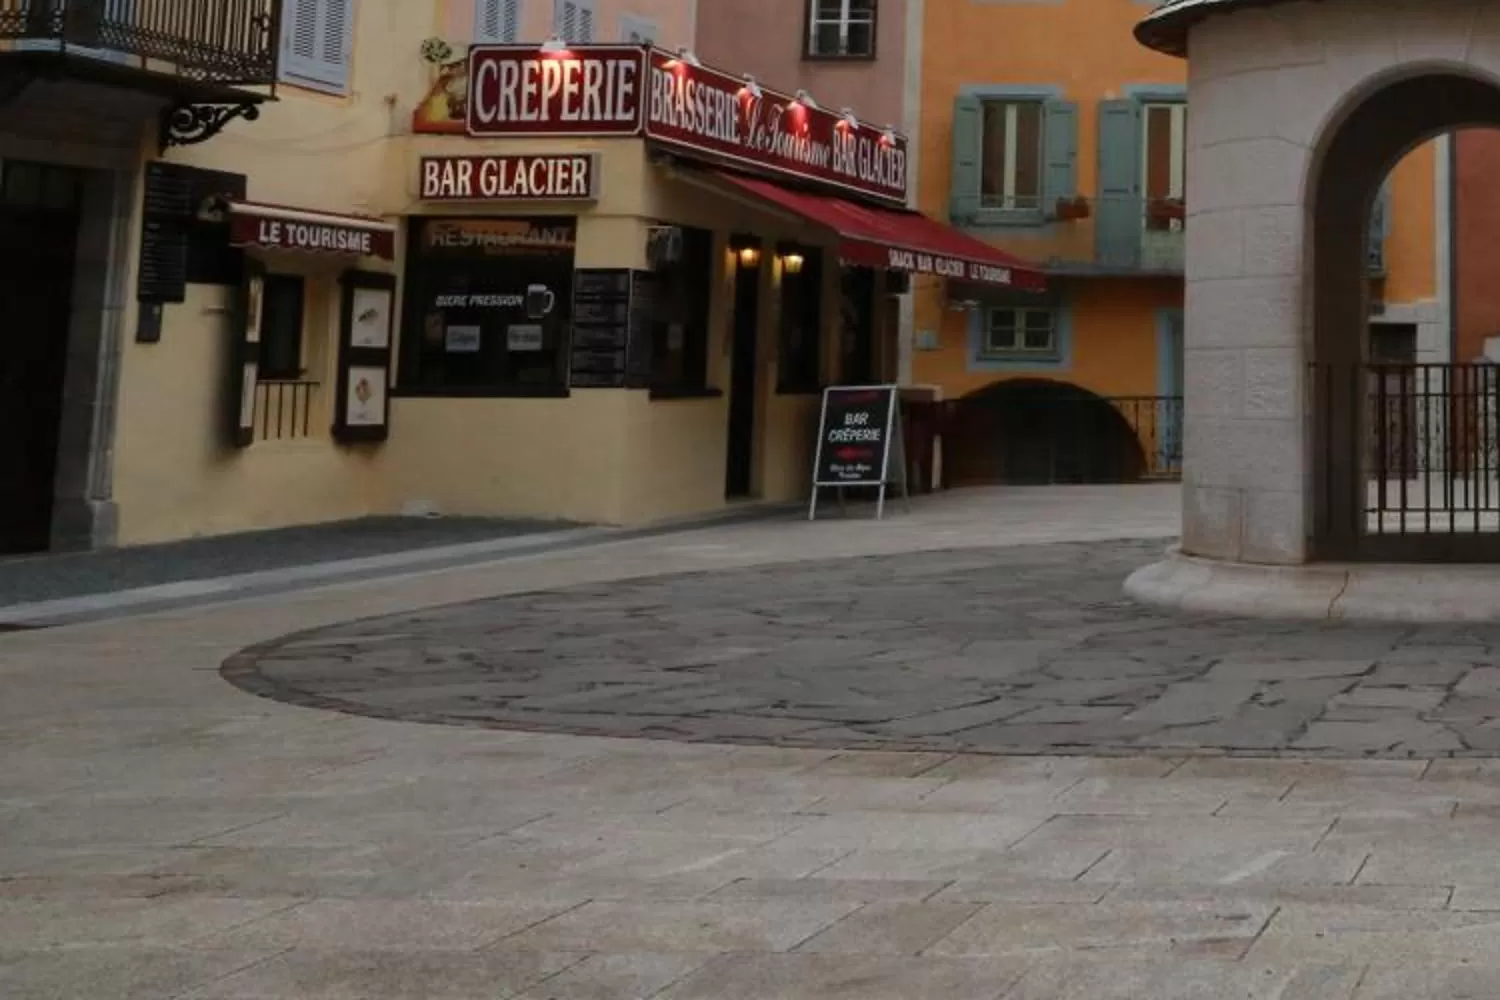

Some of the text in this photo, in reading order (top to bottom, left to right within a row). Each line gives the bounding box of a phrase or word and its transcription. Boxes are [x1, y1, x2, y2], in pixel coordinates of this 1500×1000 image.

[475, 59, 636, 123] CREPERIE
[650, 67, 906, 191] BRASSERIE Le Tourisme BAR GLACIER
[424, 158, 587, 197] BAR GLACIER
[259, 221, 371, 253] LE TOURISME
[888, 248, 915, 269] SNACK
[917, 255, 933, 271] BAR
[935, 258, 965, 277] GLACIER
[969, 263, 980, 279] LE
[469, 295, 524, 307] PRESSION
[845, 412, 869, 425] BAR
